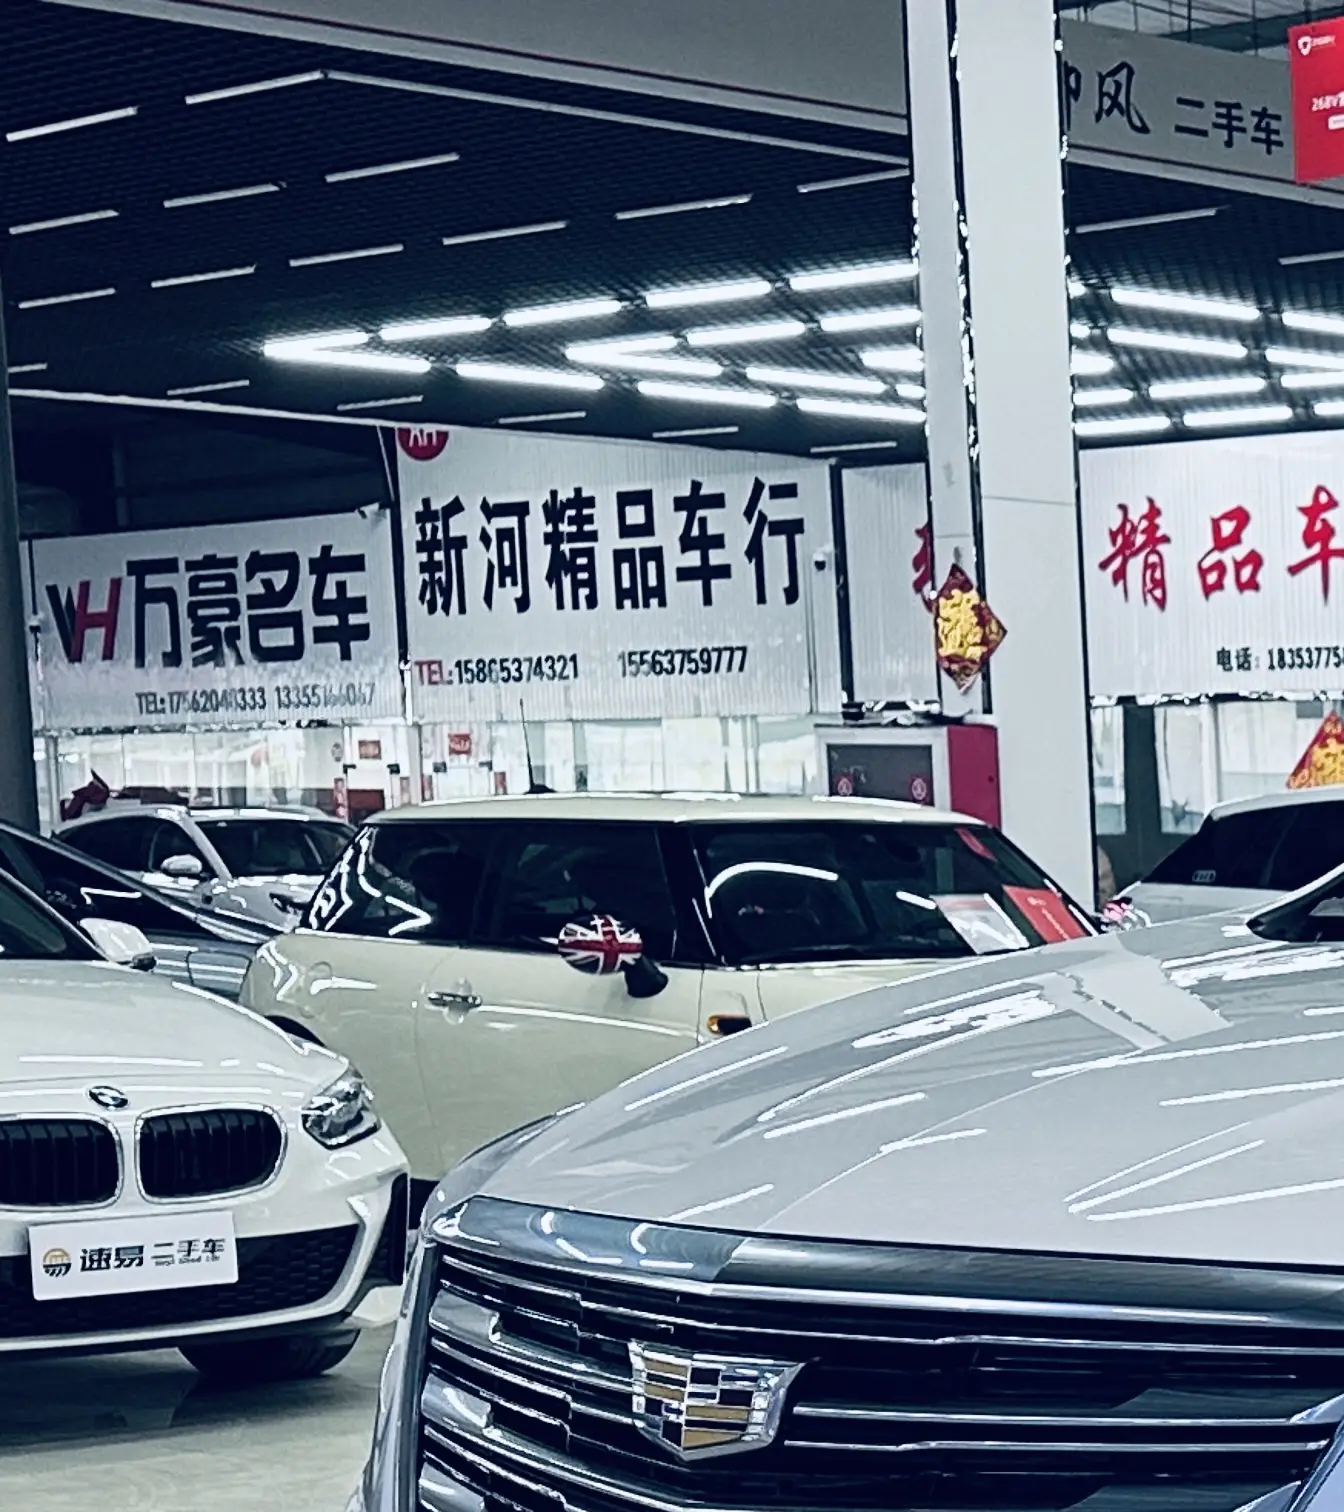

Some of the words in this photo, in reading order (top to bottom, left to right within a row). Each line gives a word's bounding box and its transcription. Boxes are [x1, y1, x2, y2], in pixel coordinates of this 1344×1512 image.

[1174, 96, 1284, 155] 二手车
[415, 477, 804, 616] 新河精品车行
[125, 545, 371, 670] 万豪名车
[619, 645, 747, 679] 15563759777
